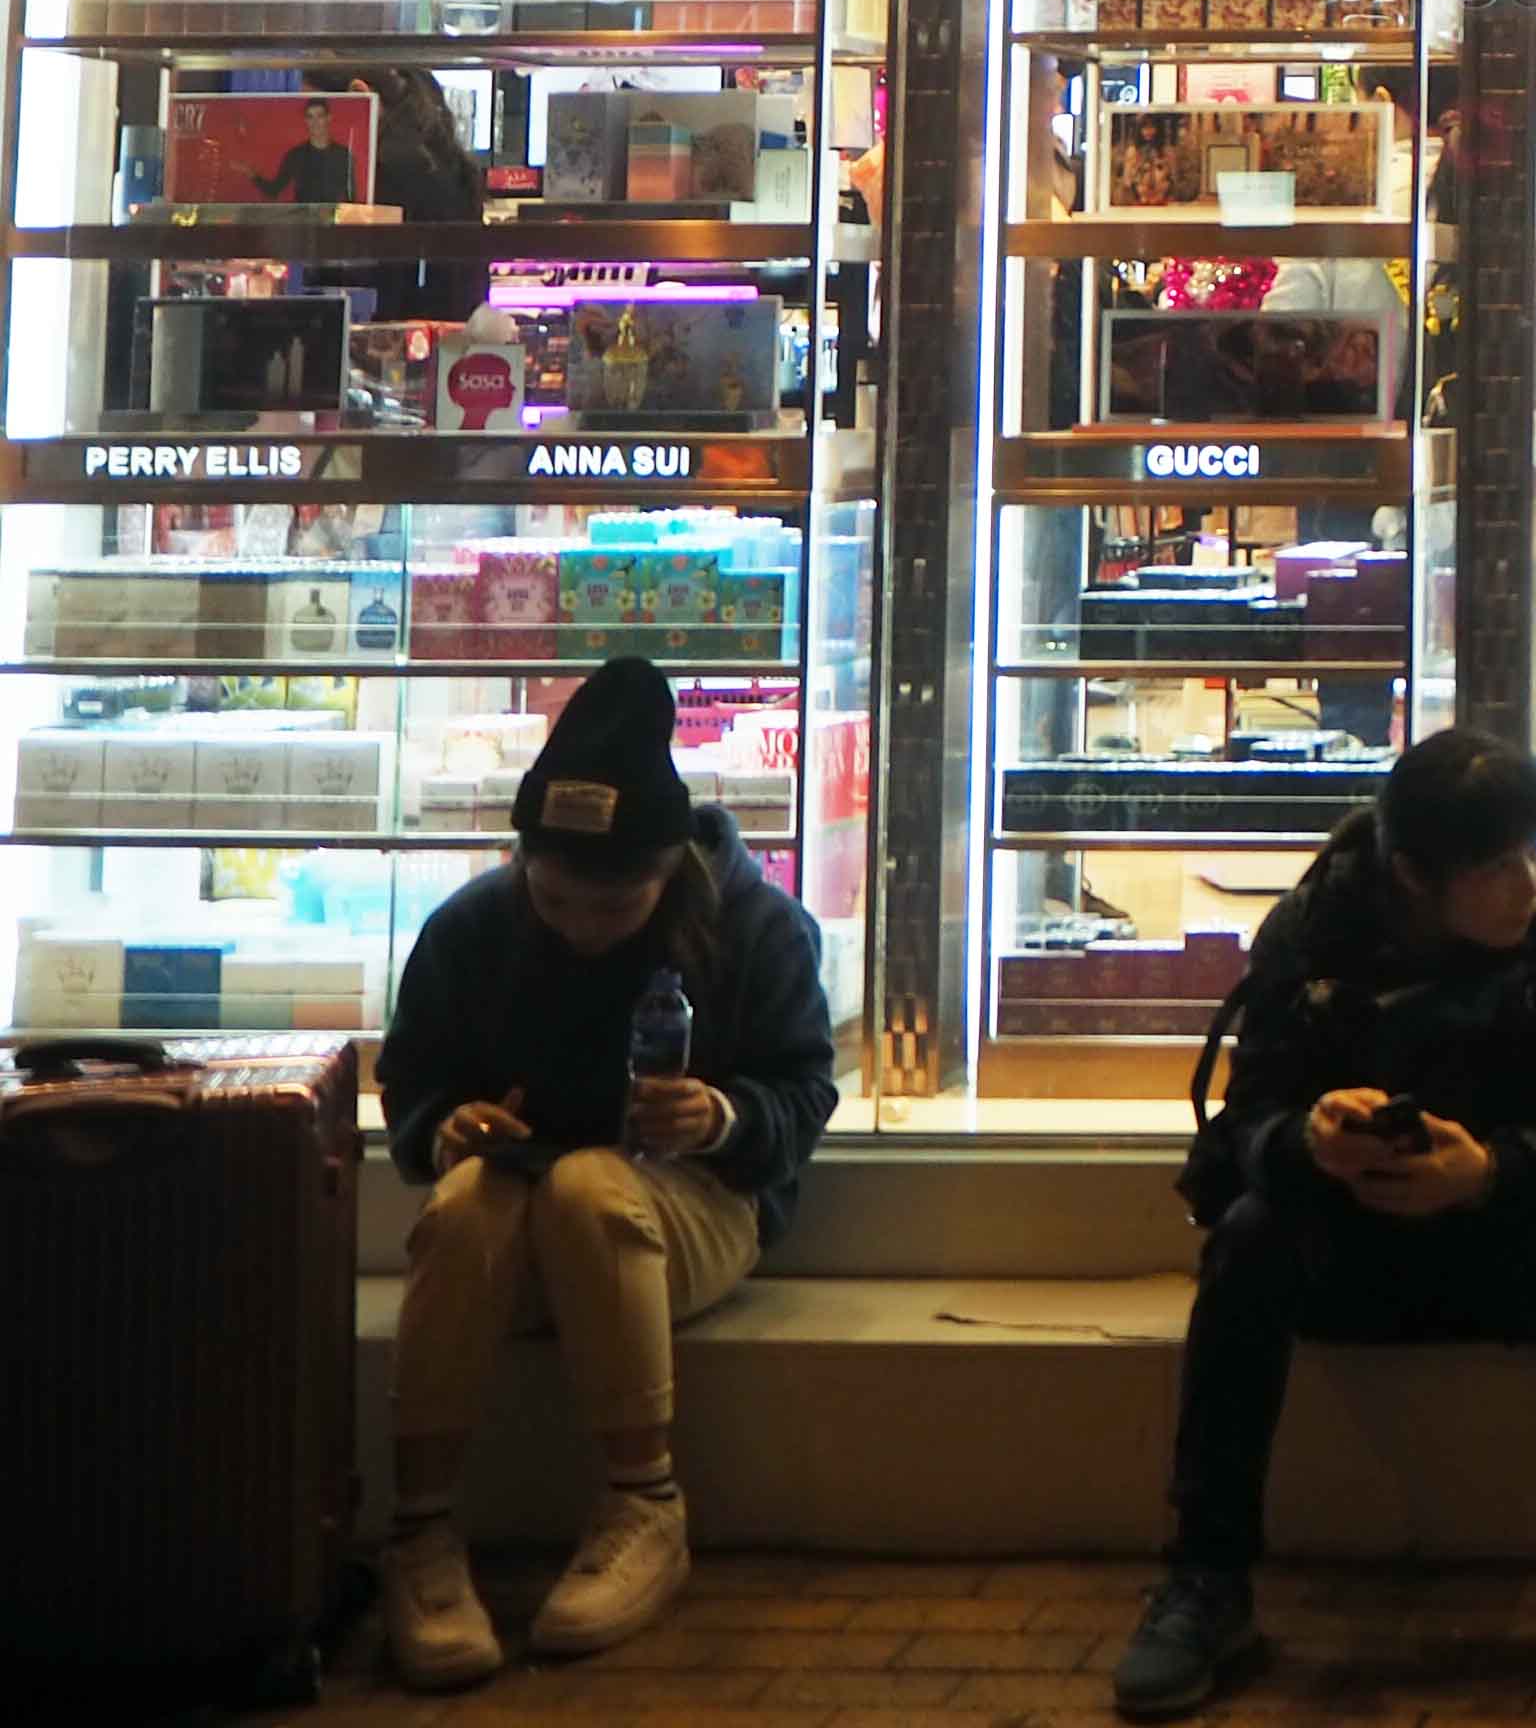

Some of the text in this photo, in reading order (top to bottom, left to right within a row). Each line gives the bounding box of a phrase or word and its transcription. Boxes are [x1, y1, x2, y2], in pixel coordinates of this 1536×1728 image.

[172, 104, 206, 130] CR7
[458, 370, 506, 391] sasa
[84, 445, 303, 478] PERRY ELLIS
[528, 445, 690, 477] ANNA SUI
[1147, 444, 1260, 477] GUCCI
